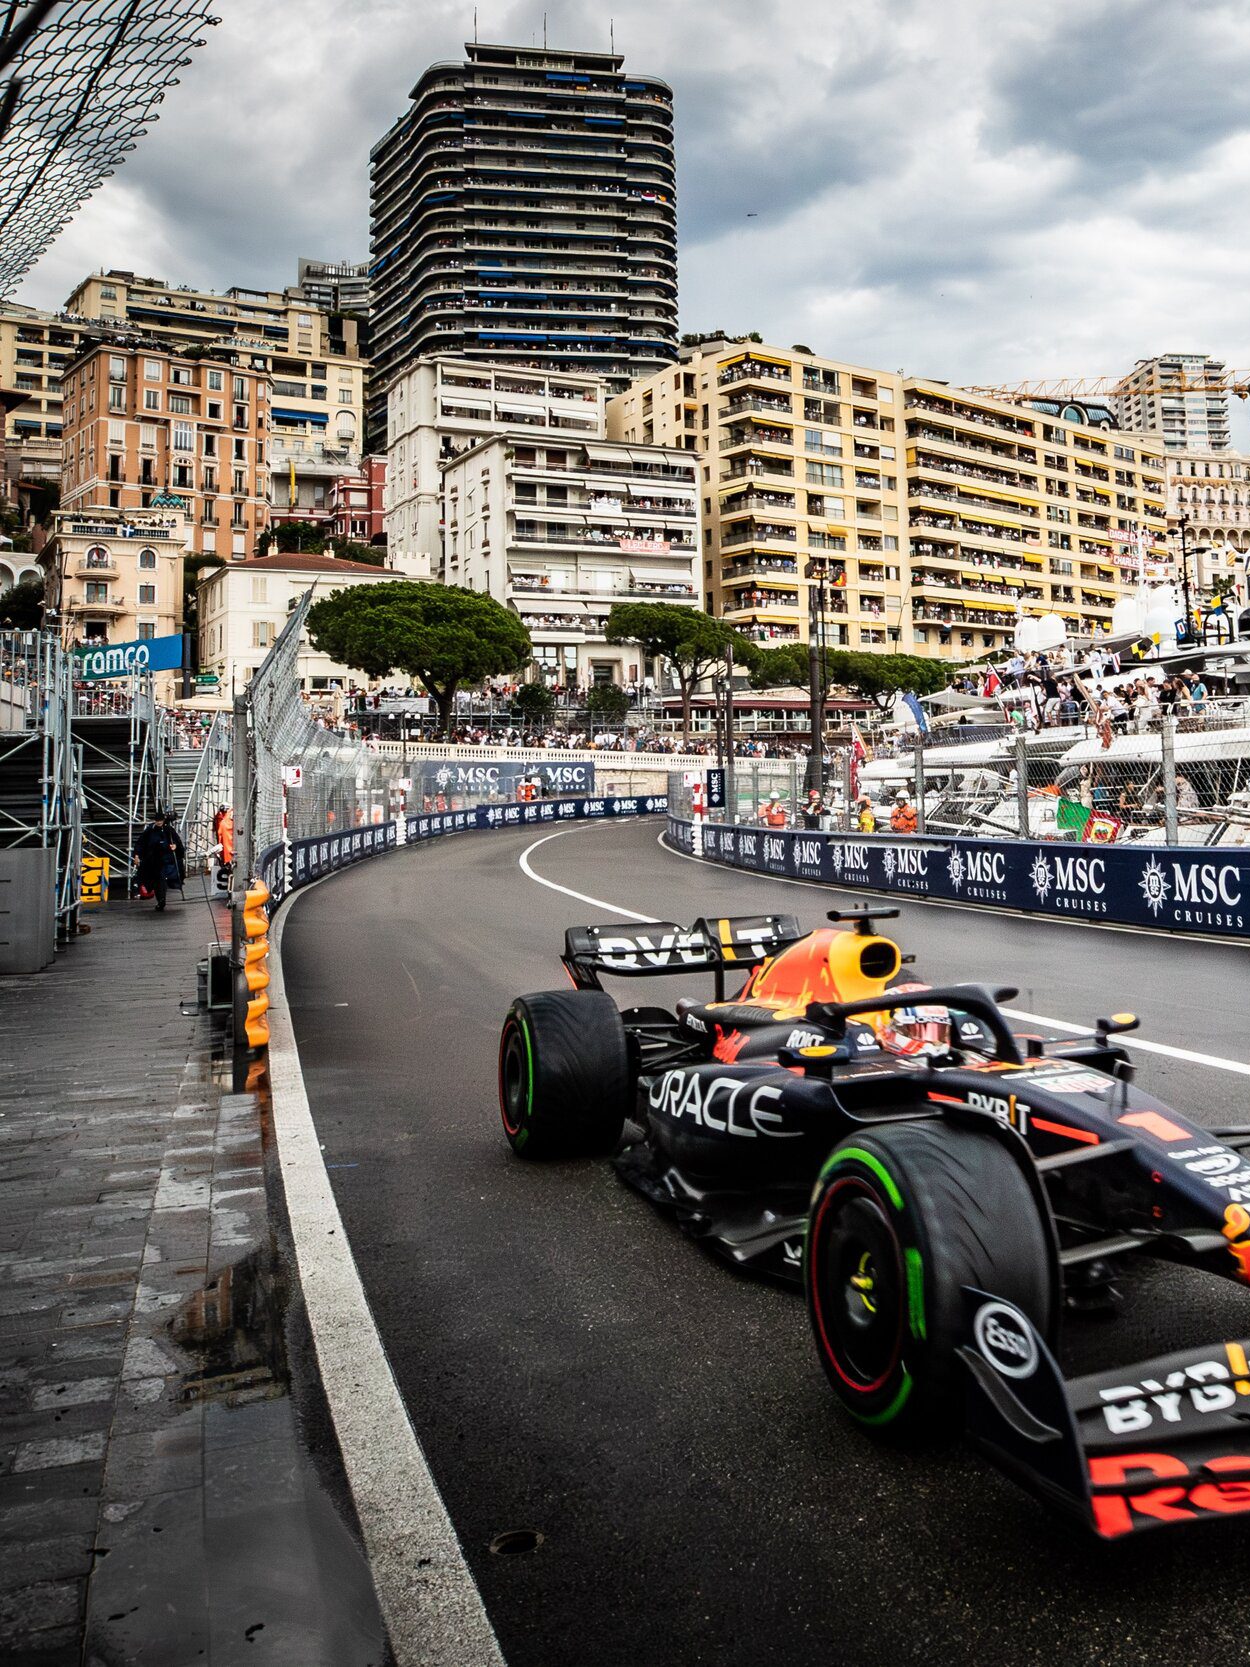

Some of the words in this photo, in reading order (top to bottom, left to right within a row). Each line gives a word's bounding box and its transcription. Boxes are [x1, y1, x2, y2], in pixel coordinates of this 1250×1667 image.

[457, 767, 499, 784] MSC
[590, 801, 605, 812] MSC
[621, 800, 637, 810] MSC
[654, 799, 667, 808] MS
[770, 839, 785, 860] MSC
[802, 841, 820, 864] MSC
[844, 843, 868, 869] MSC
[898, 848, 928, 875] MSC
[966, 851, 1005, 883] MSC
[1054, 857, 1106, 894] MSC
[1172, 863, 1241, 906] MSC
[967, 886, 1006, 900] CRUISES
[1056, 897, 1107, 912] CRUISES
[1174, 909, 1243, 927] CRUISES
